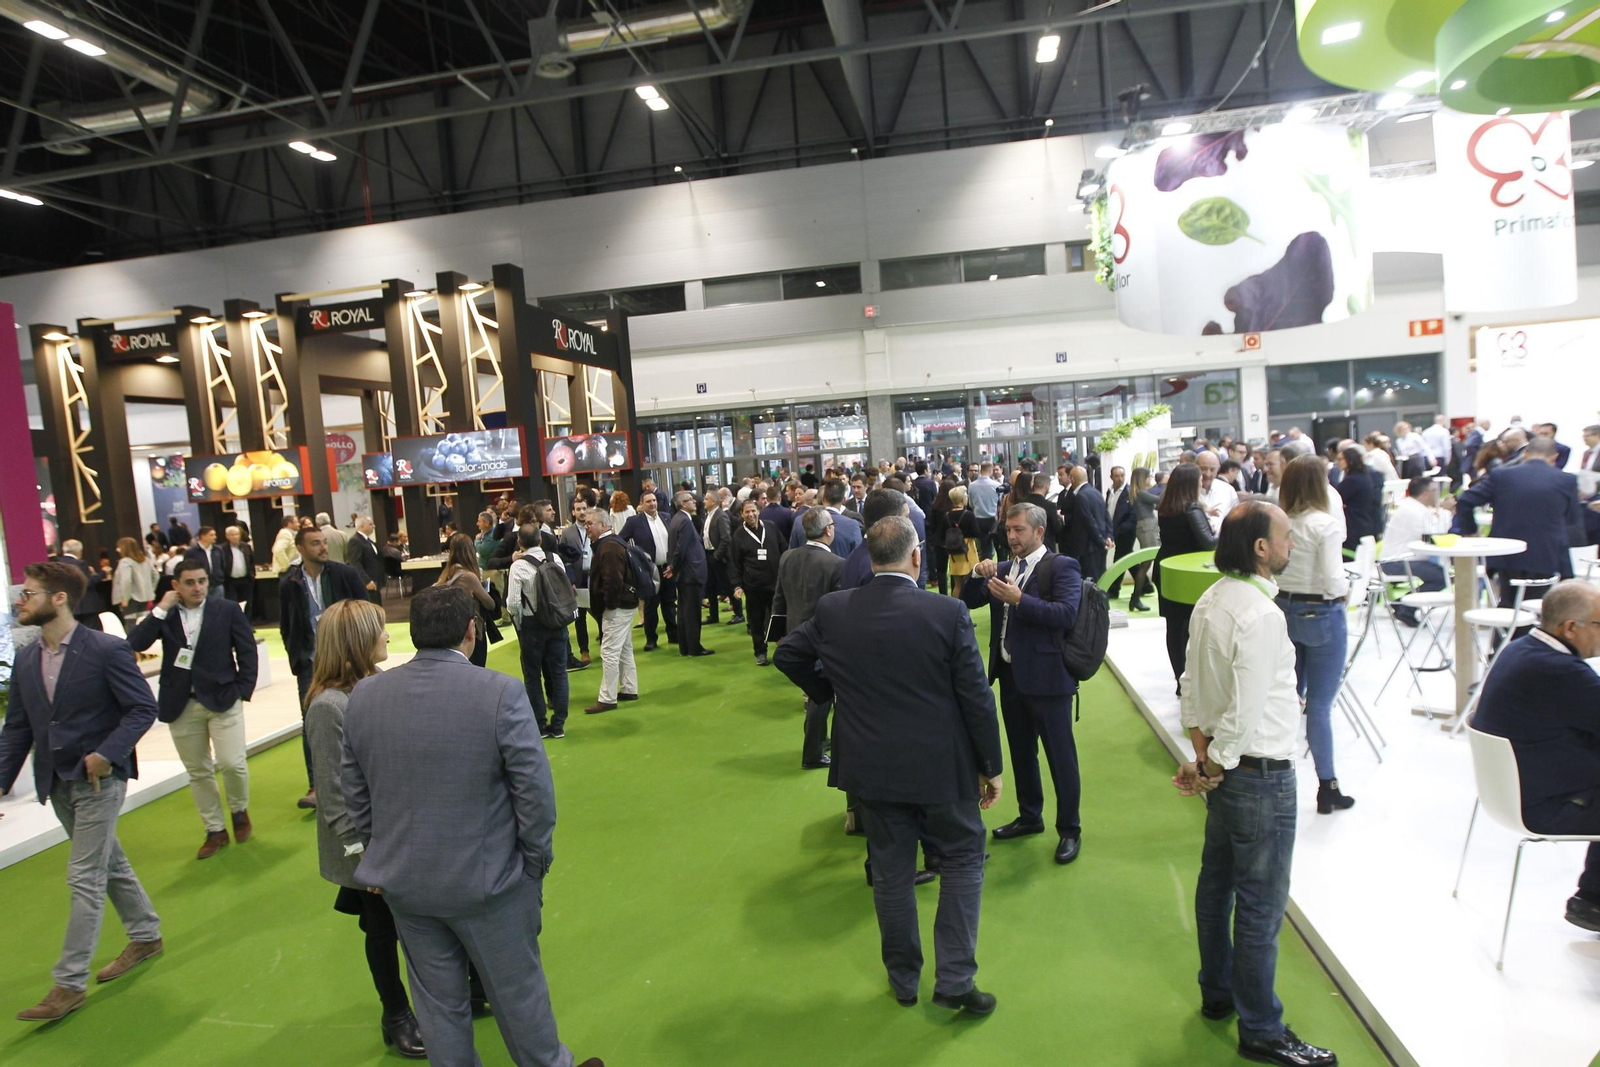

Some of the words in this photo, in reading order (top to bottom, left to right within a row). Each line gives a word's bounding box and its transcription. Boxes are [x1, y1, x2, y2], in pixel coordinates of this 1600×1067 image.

[330, 307, 375, 326] ROYAL
[129, 332, 171, 350] ROYAL
[567, 327, 597, 355] ROYAL
[454, 458, 508, 472] Tailor-made
